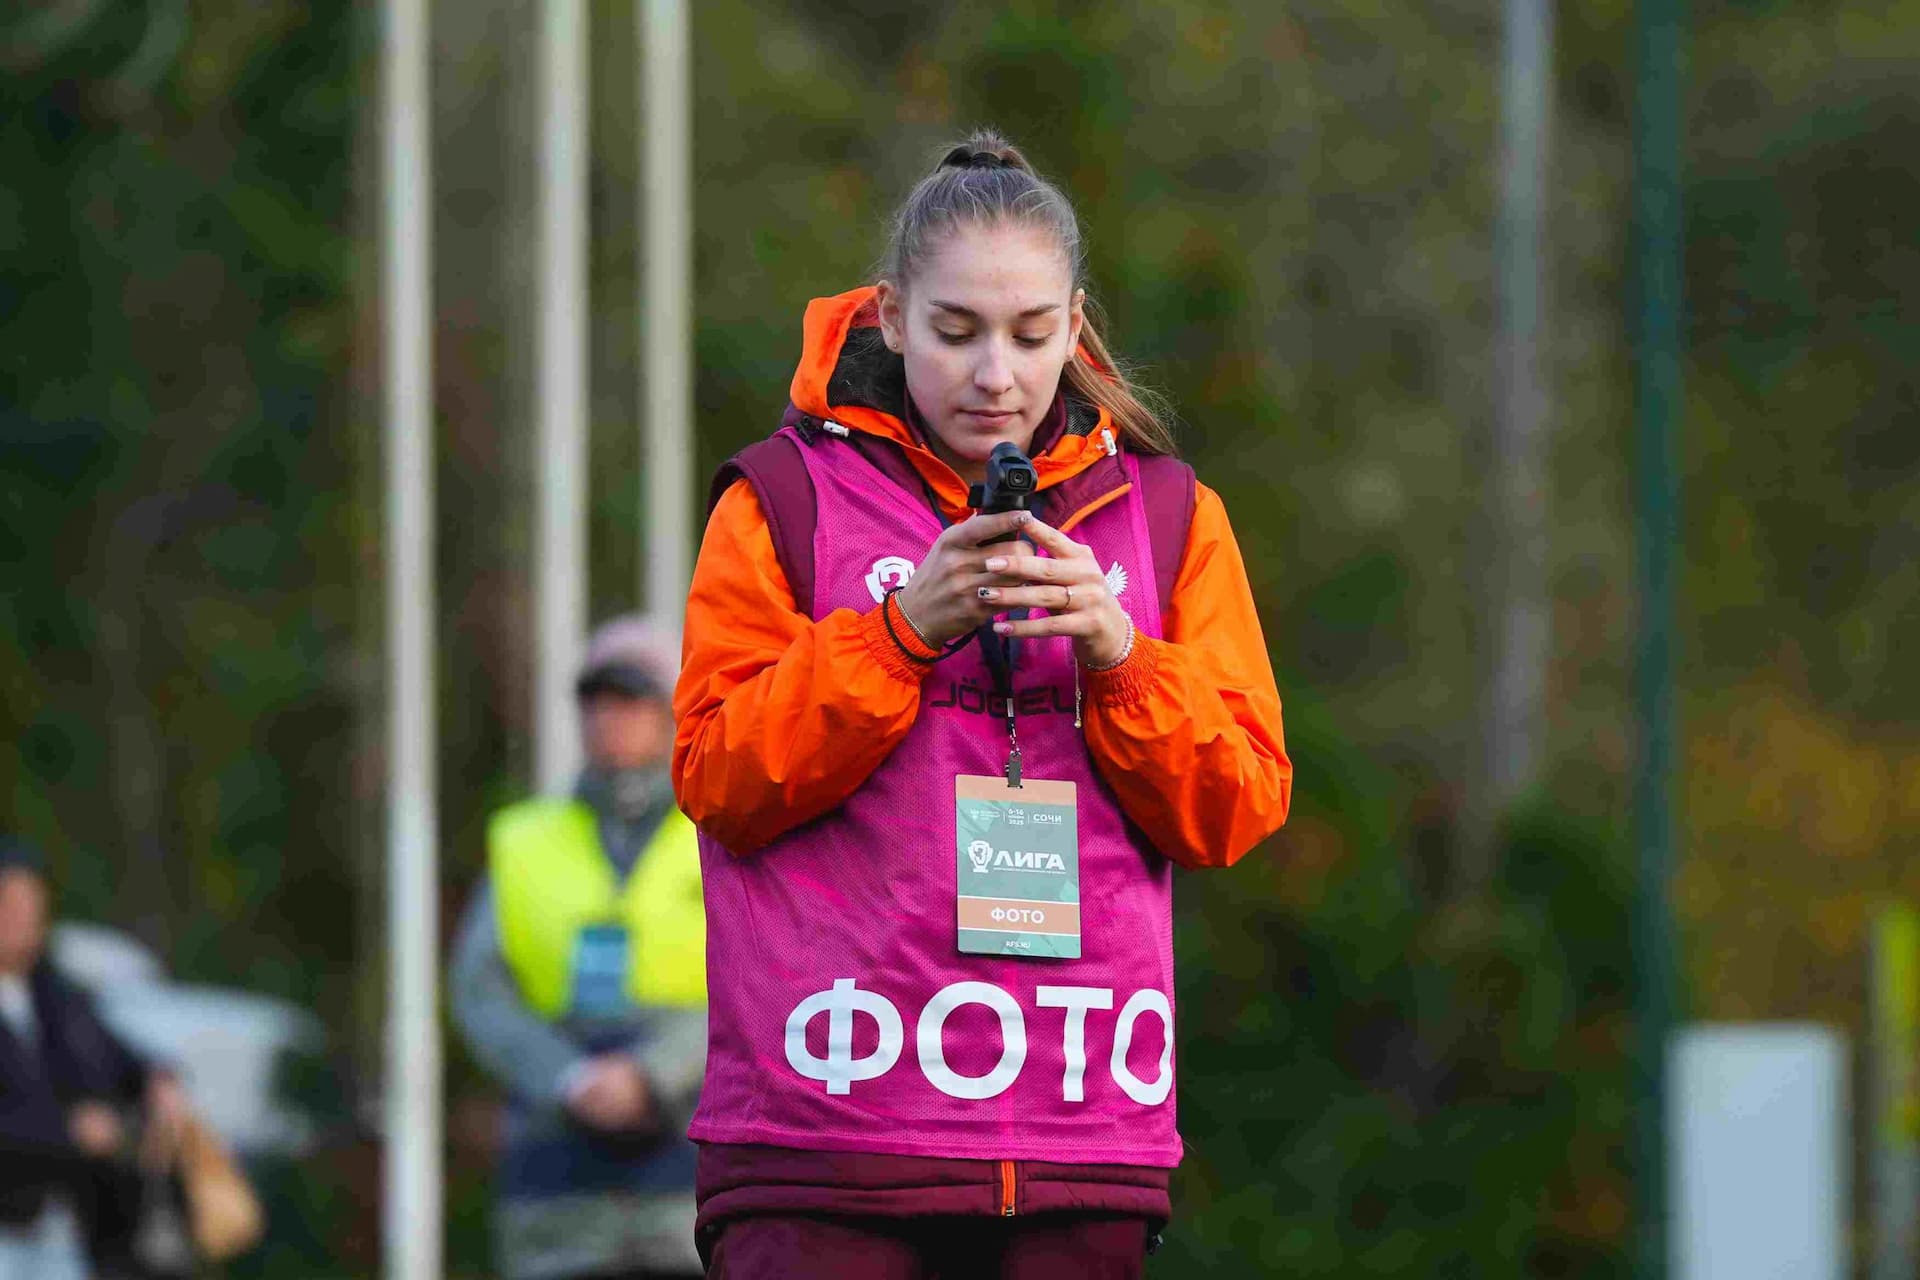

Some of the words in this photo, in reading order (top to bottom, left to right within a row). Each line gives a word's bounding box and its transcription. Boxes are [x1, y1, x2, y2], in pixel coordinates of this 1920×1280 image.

[1033, 813, 1062, 823] СОЧИ
[993, 850, 1066, 871] ЛИГА
[991, 907, 1045, 924] ФОТО
[784, 978, 1174, 1106] ФОТО
